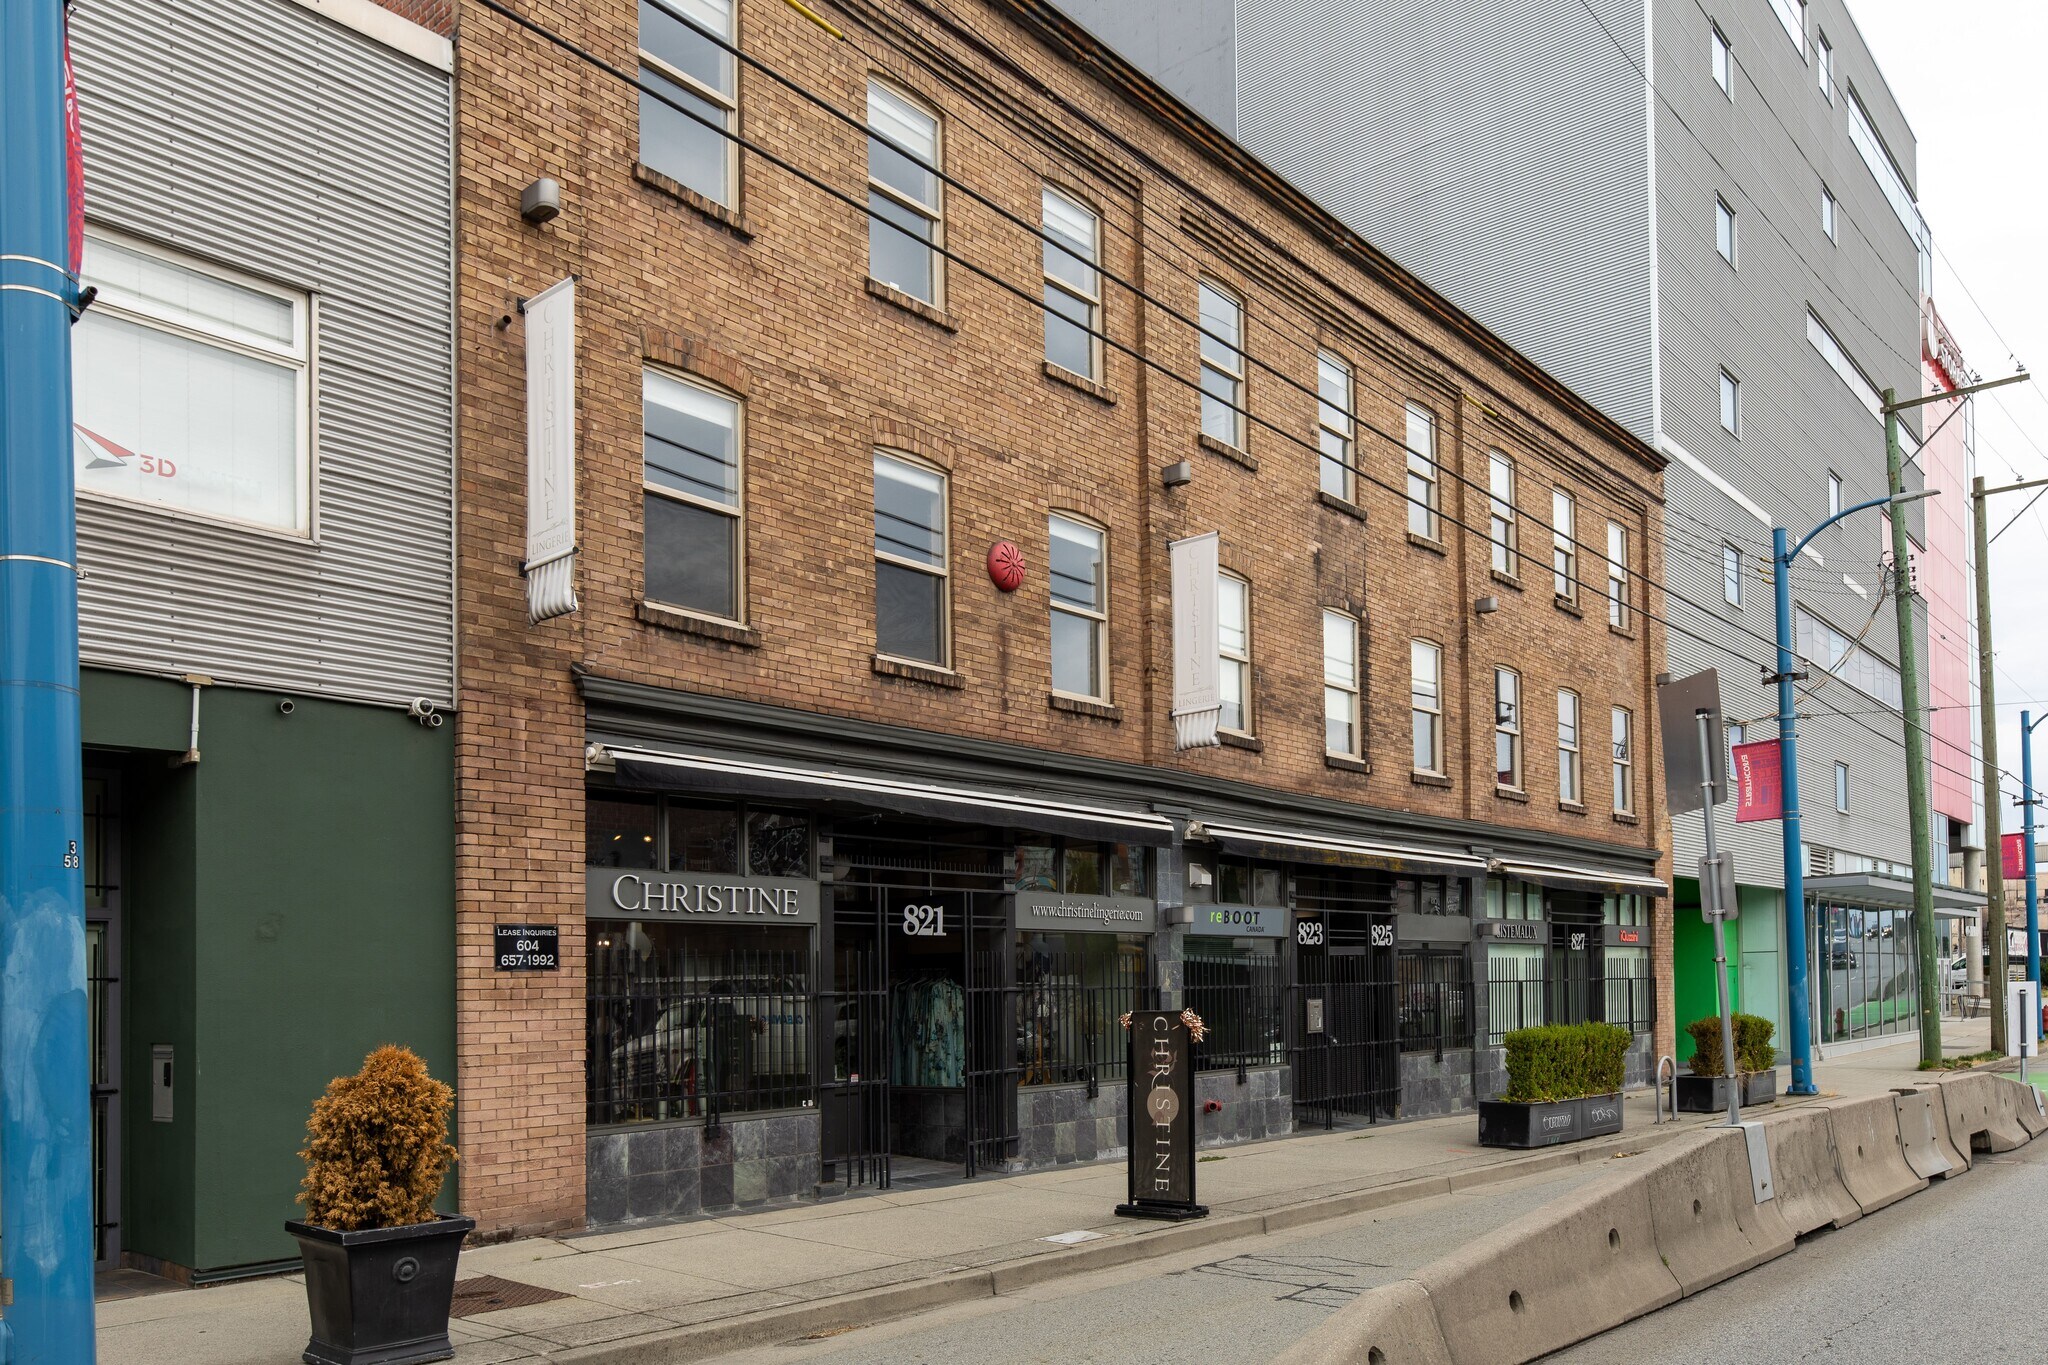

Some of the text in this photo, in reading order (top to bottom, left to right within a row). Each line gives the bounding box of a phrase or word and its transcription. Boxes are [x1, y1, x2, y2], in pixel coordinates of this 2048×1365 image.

[543, 301, 556, 521] CHRISTINE
[140, 454, 176, 477] 3D
[532, 531, 569, 555] LINGERIE
[1189, 545, 1200, 686] CHRISTINE
[1179, 692, 1215, 708] LINGERIE
[70, 841, 76, 854] 3
[613, 874, 799, 916] CHRISTINE
[903, 904, 947, 936] 821
[1032, 900, 1143, 925] www.christinelingerie.com
[497, 928, 521, 936] LEASE
[1298, 922, 1323, 945] 823
[1371, 924, 1393, 946] 825
[1571, 932, 1585, 950] 827
[516, 940, 539, 951] 604
[501, 954, 555, 966] 657-1992
[1152, 1016, 1171, 1192] CHRISTINE
